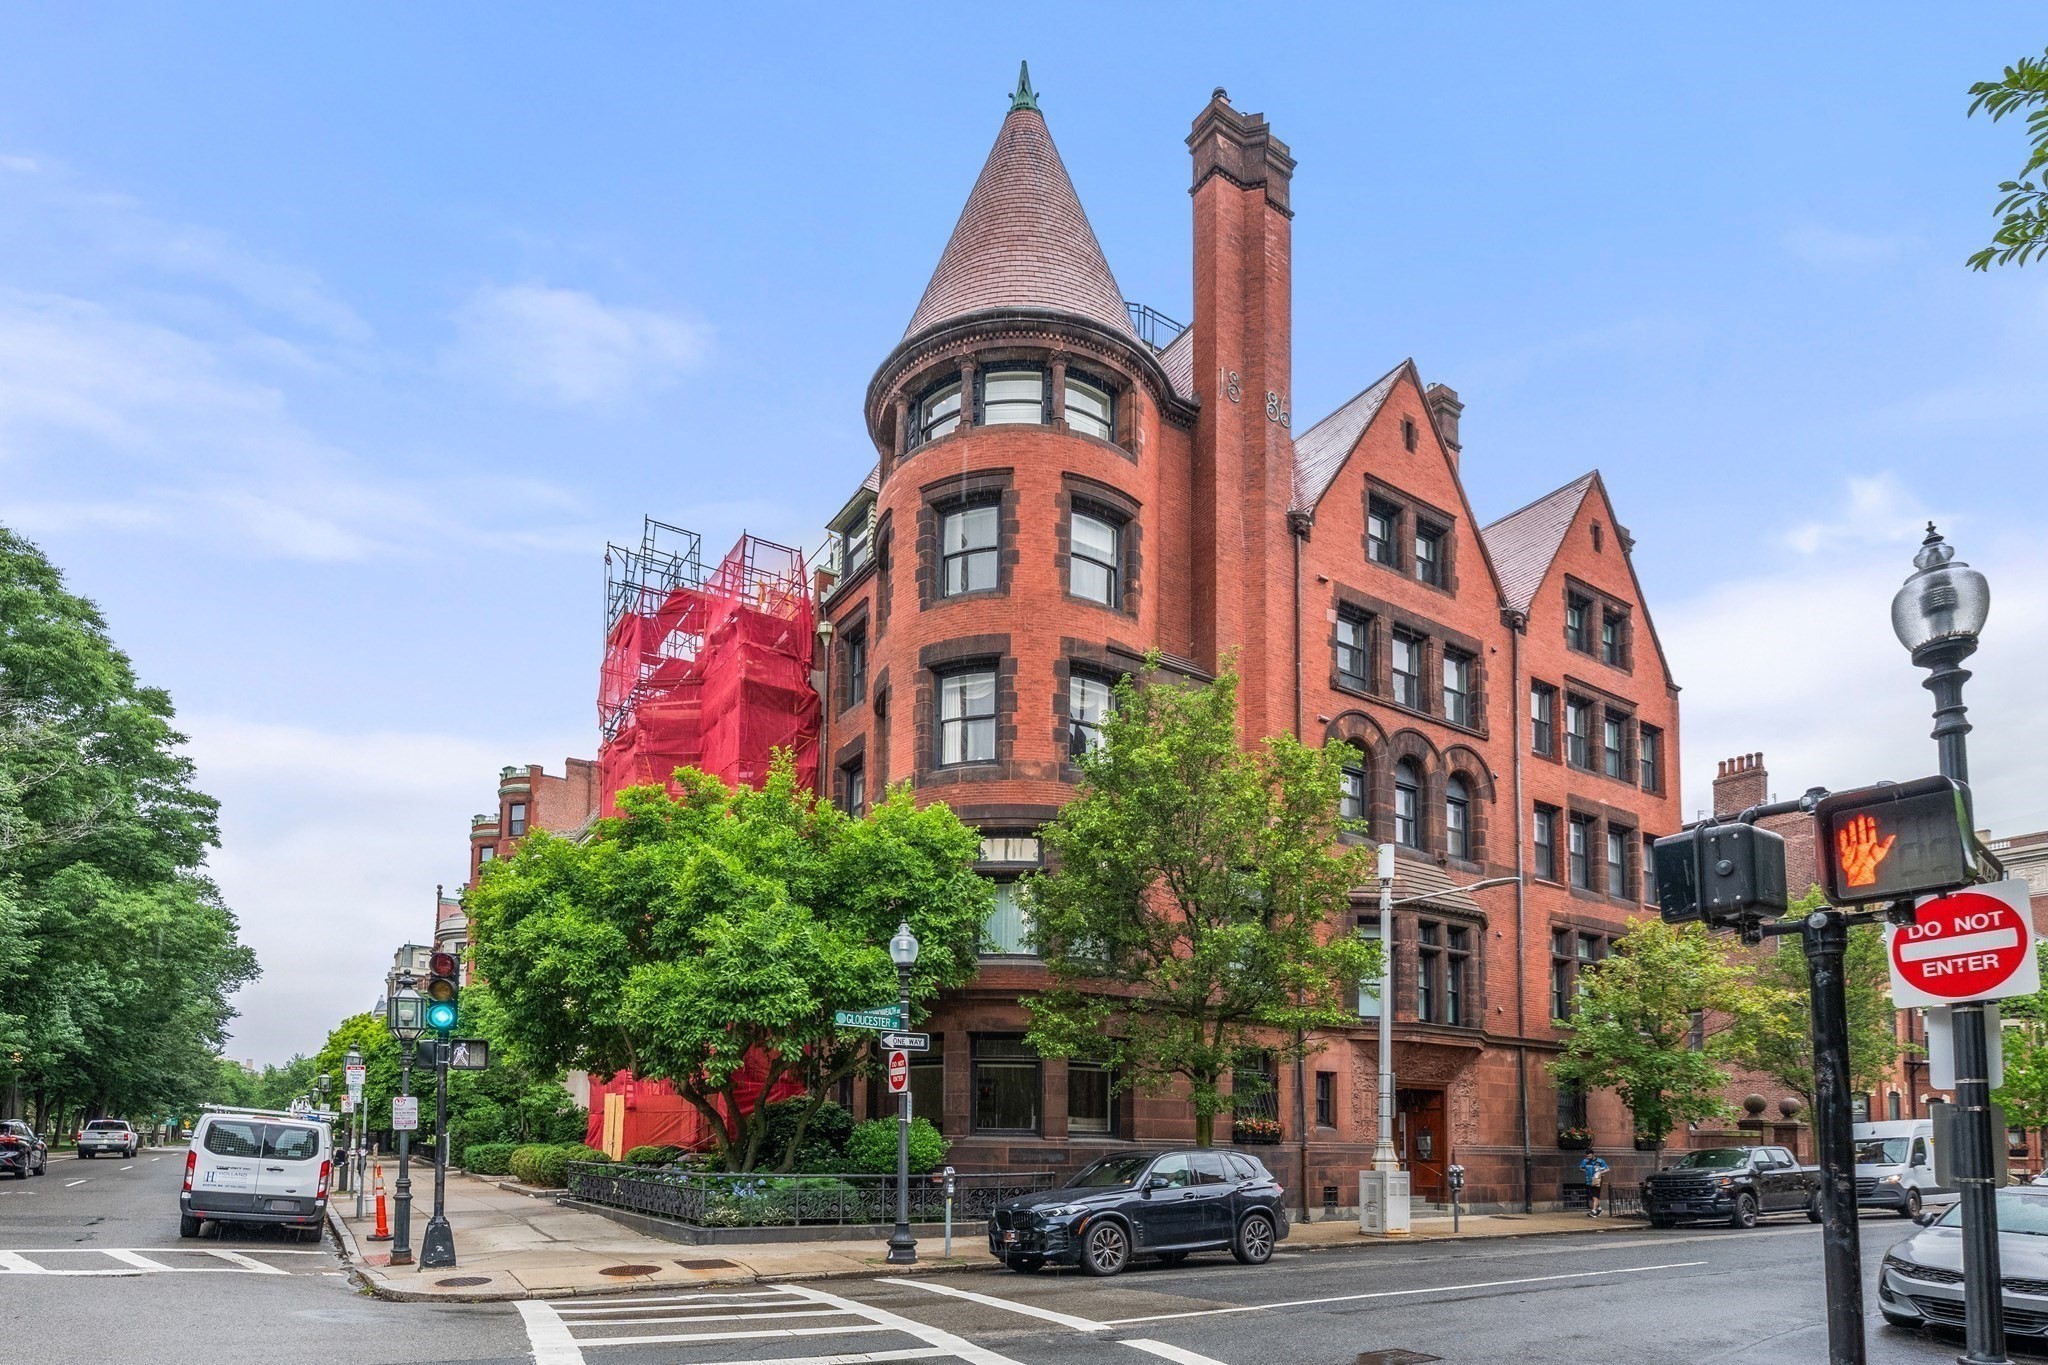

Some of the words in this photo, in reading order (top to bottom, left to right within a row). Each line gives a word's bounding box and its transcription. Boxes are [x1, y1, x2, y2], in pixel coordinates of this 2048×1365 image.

[1908, 920, 1942, 940] DO
[1954, 910, 2004, 933] NOT
[1922, 953, 1999, 978] ENTER
[846, 1013, 891, 1028] GLOUCESTER
[892, 1037, 905, 1045] ONE
[908, 1038, 923, 1046] WAY
